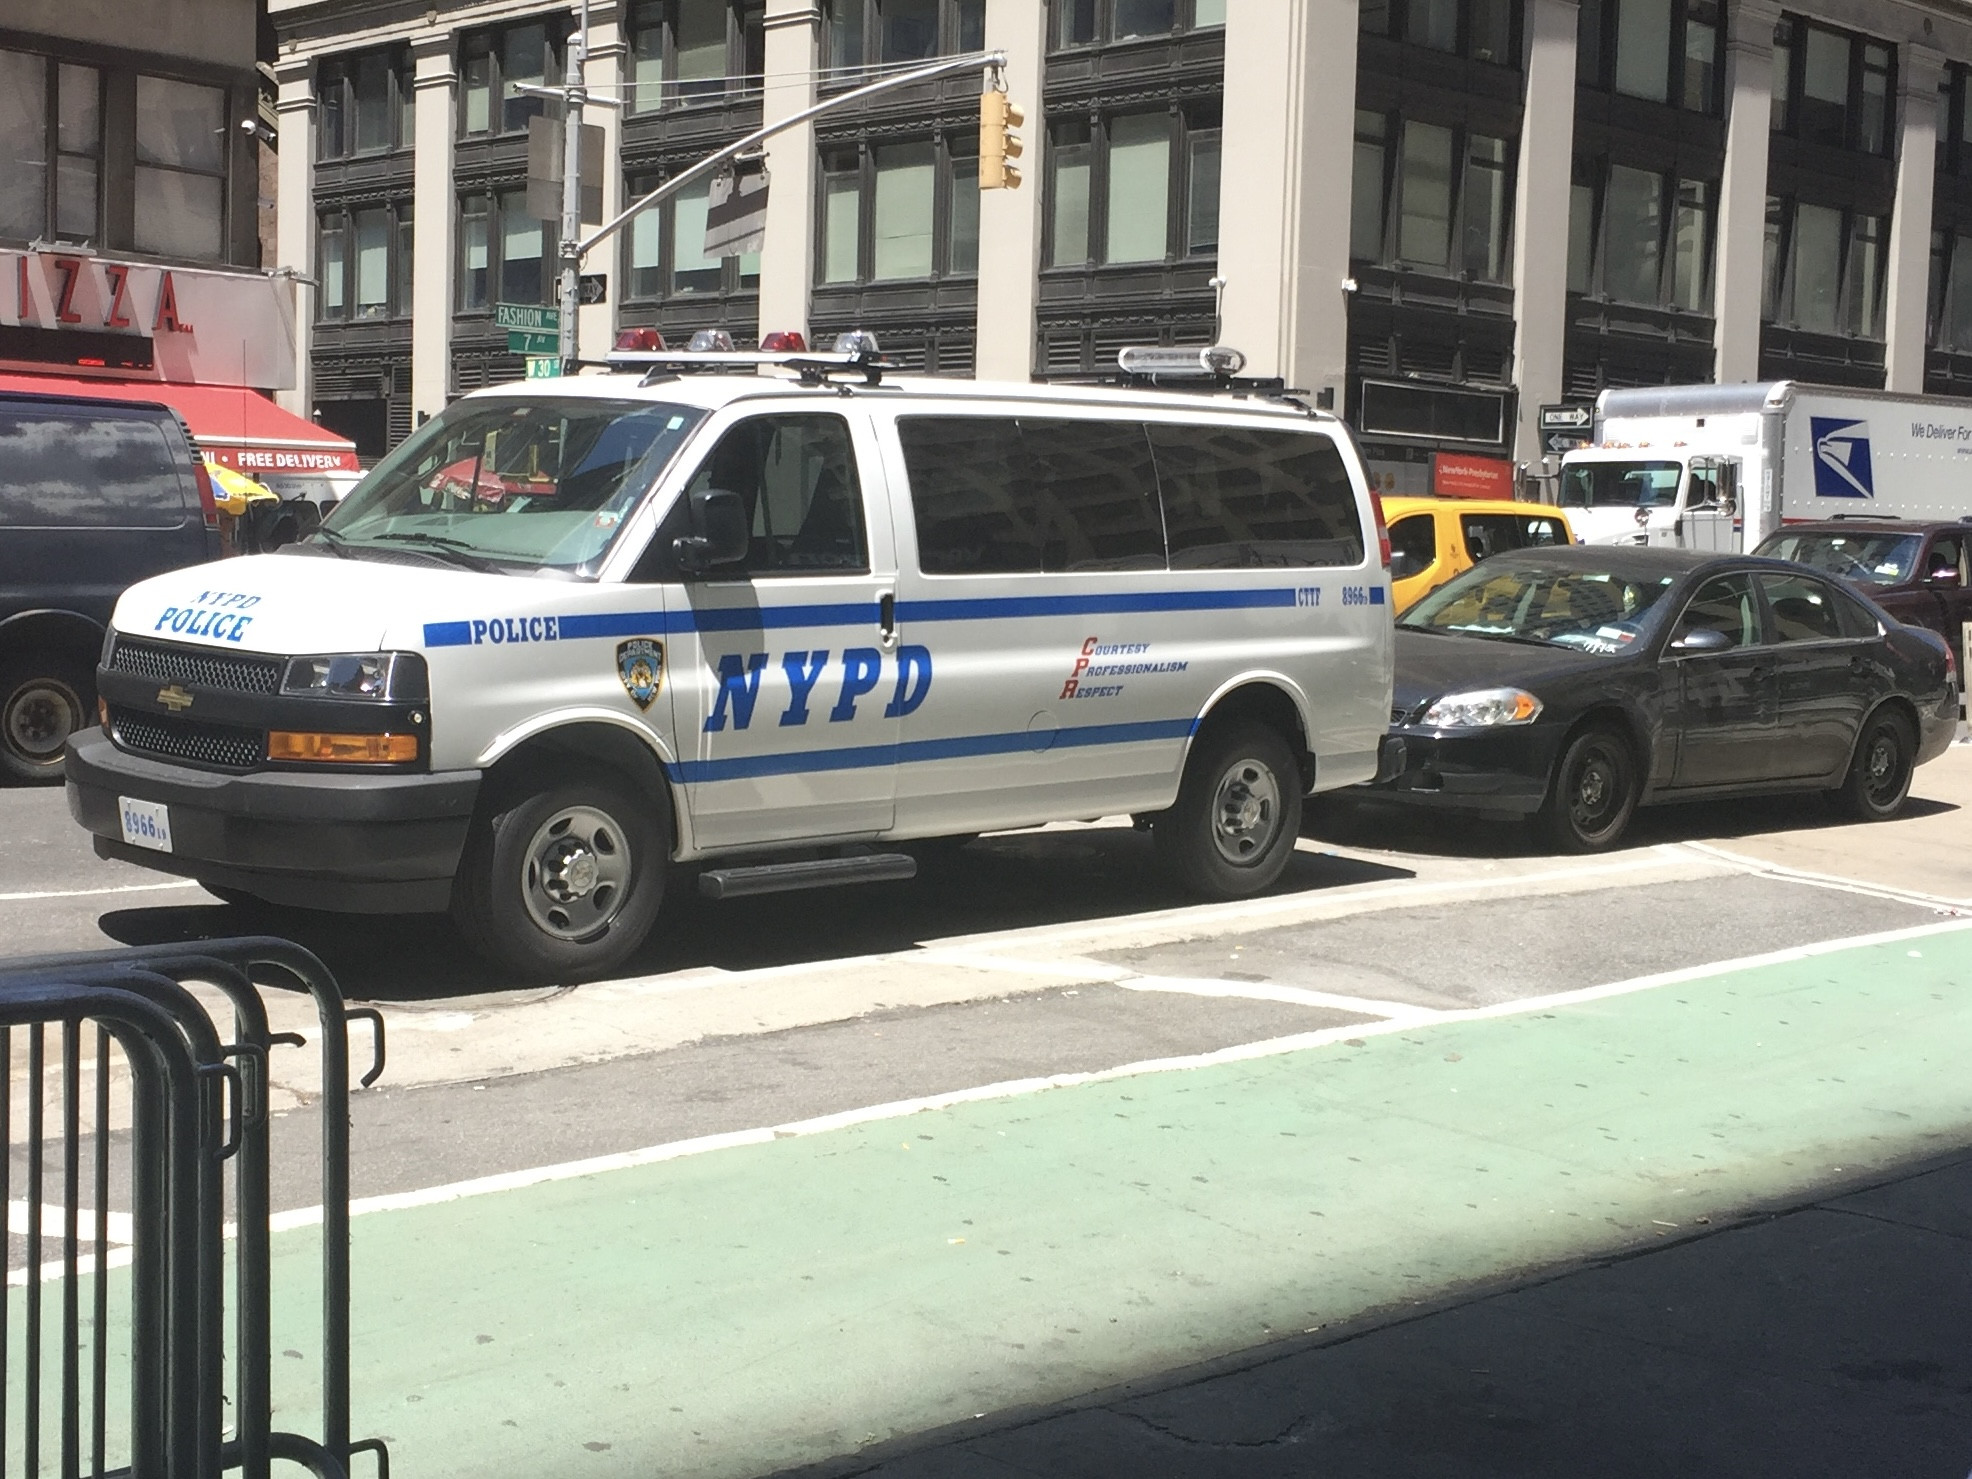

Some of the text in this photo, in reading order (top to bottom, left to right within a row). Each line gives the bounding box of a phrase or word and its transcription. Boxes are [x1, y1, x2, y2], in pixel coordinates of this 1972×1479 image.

[498, 306, 542, 327] FASHION
[523, 334, 532, 351] 7
[538, 360, 550, 377] 30
[1569, 413, 1584, 421] WAY
[1912, 422, 1972, 441] We Deliver For
[237, 453, 273, 467] FREE
[191, 590, 262, 610] NYPD
[154, 607, 254, 642] POLICE
[473, 616, 557, 645] POLICE
[1081, 636, 1150, 656] COURTESY
[1071, 658, 1188, 677] PROFESSIONALISM
[703, 645, 932, 732] NYPD
[1059, 679, 1124, 699] RESPECT
